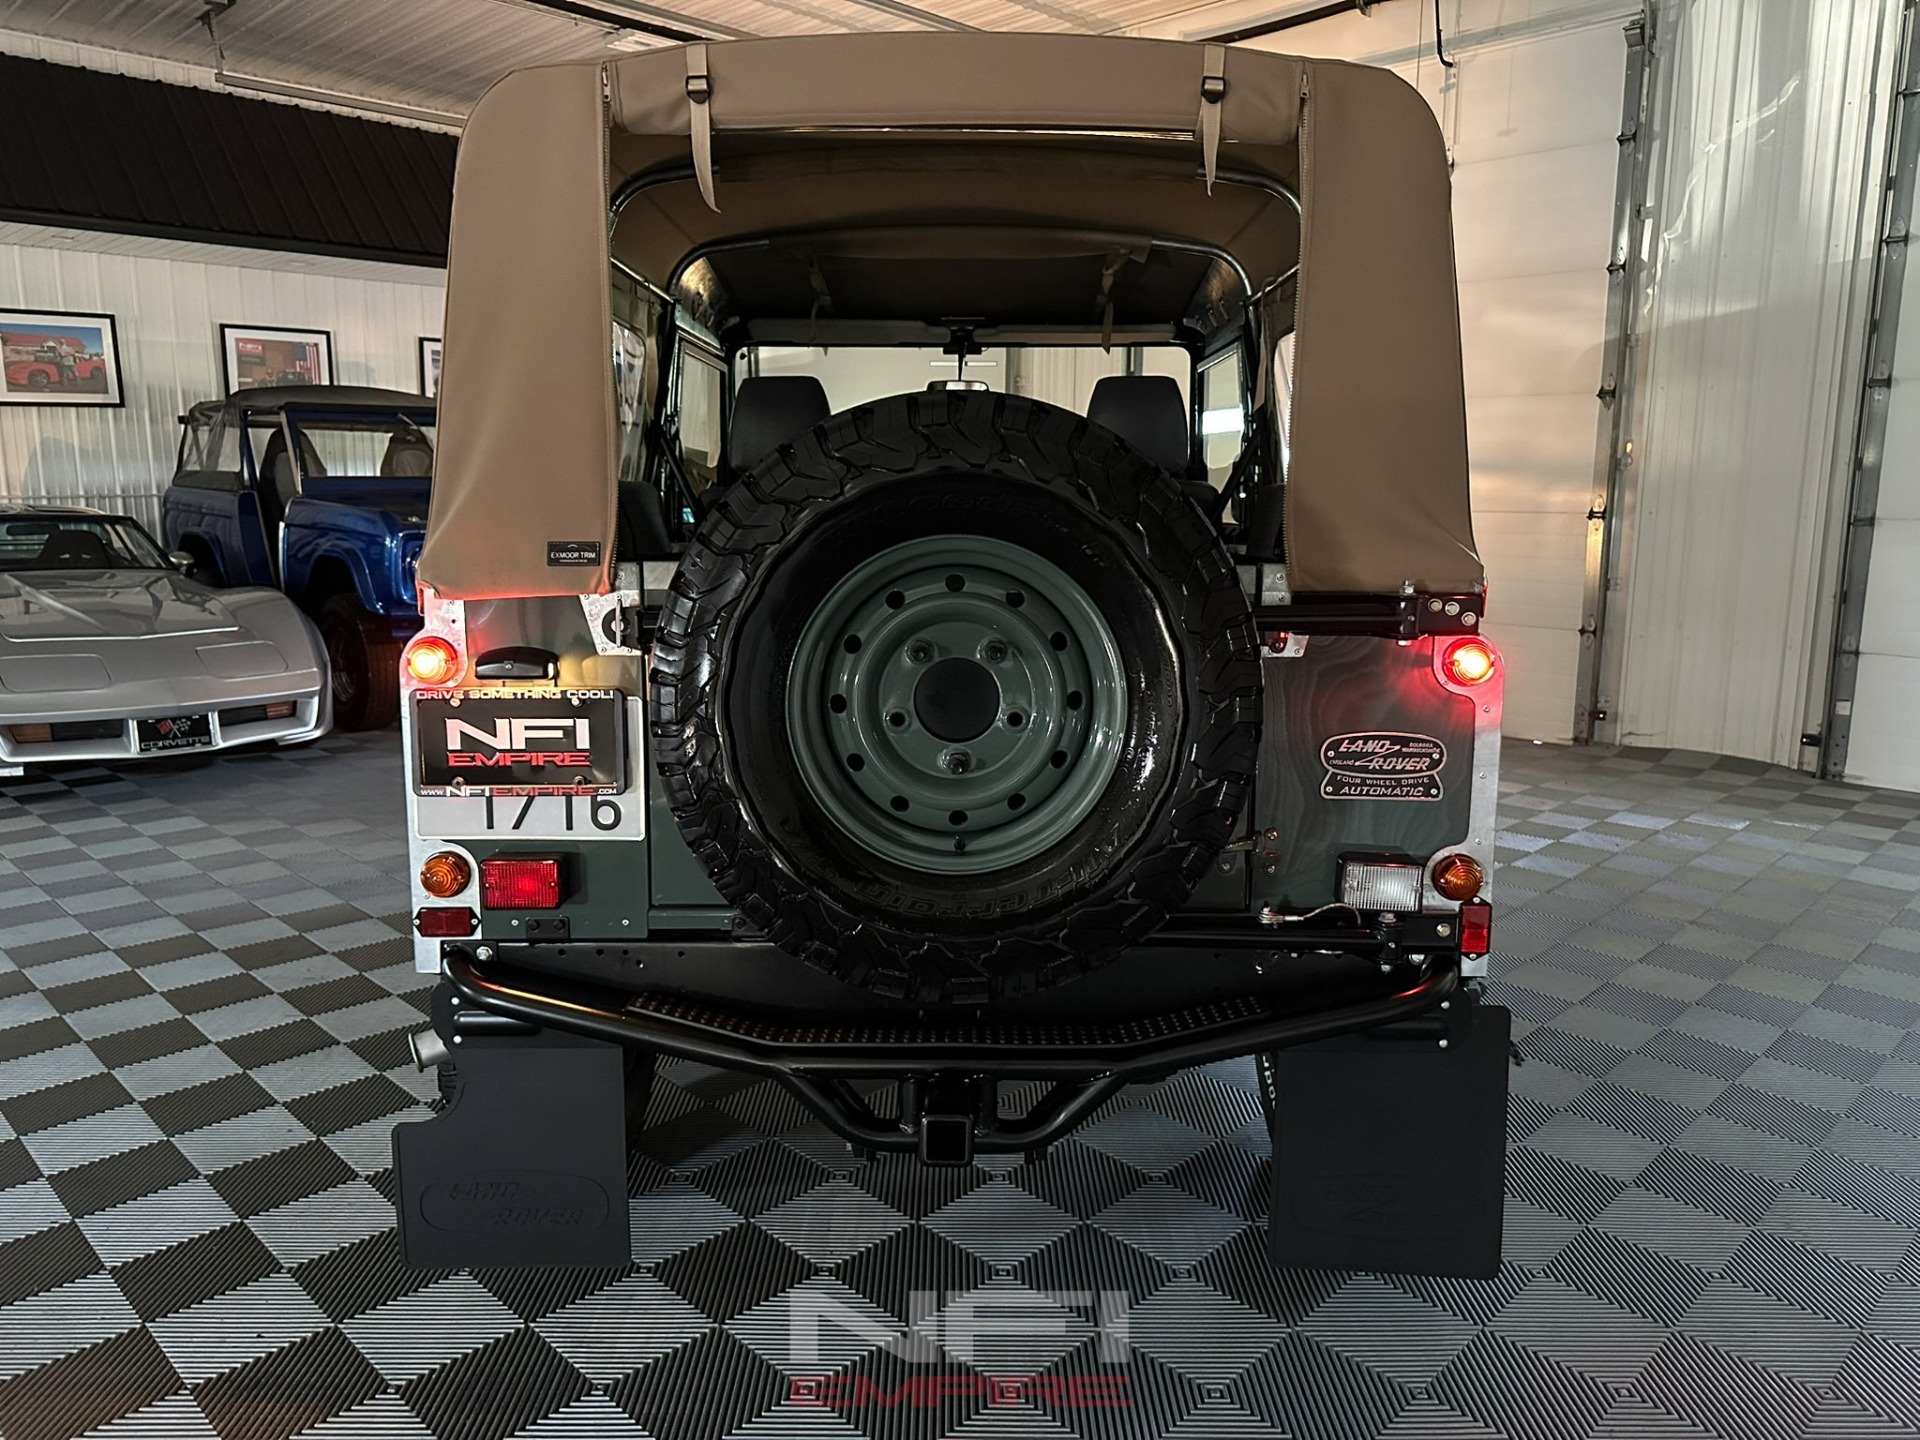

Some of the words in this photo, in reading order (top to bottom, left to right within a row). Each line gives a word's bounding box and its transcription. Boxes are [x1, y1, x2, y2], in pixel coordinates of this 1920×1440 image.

[550, 551, 579, 559] EXMOOR
[416, 690, 464, 700] DRIVE
[468, 689, 562, 699] SOMETHING
[566, 690, 614, 699] COOL!
[445, 718, 590, 750] NFI
[141, 736, 210, 749] CORVETTE
[1338, 739, 1391, 753] LAND
[447, 752, 591, 767] EMPIRE
[1367, 757, 1431, 771] ROVER
[1336, 774, 1362, 785] FOUR
[1365, 778, 1397, 786] WHEEL
[1401, 777, 1430, 786] DRIVE
[1339, 786, 1424, 796] AUTOMATIC
